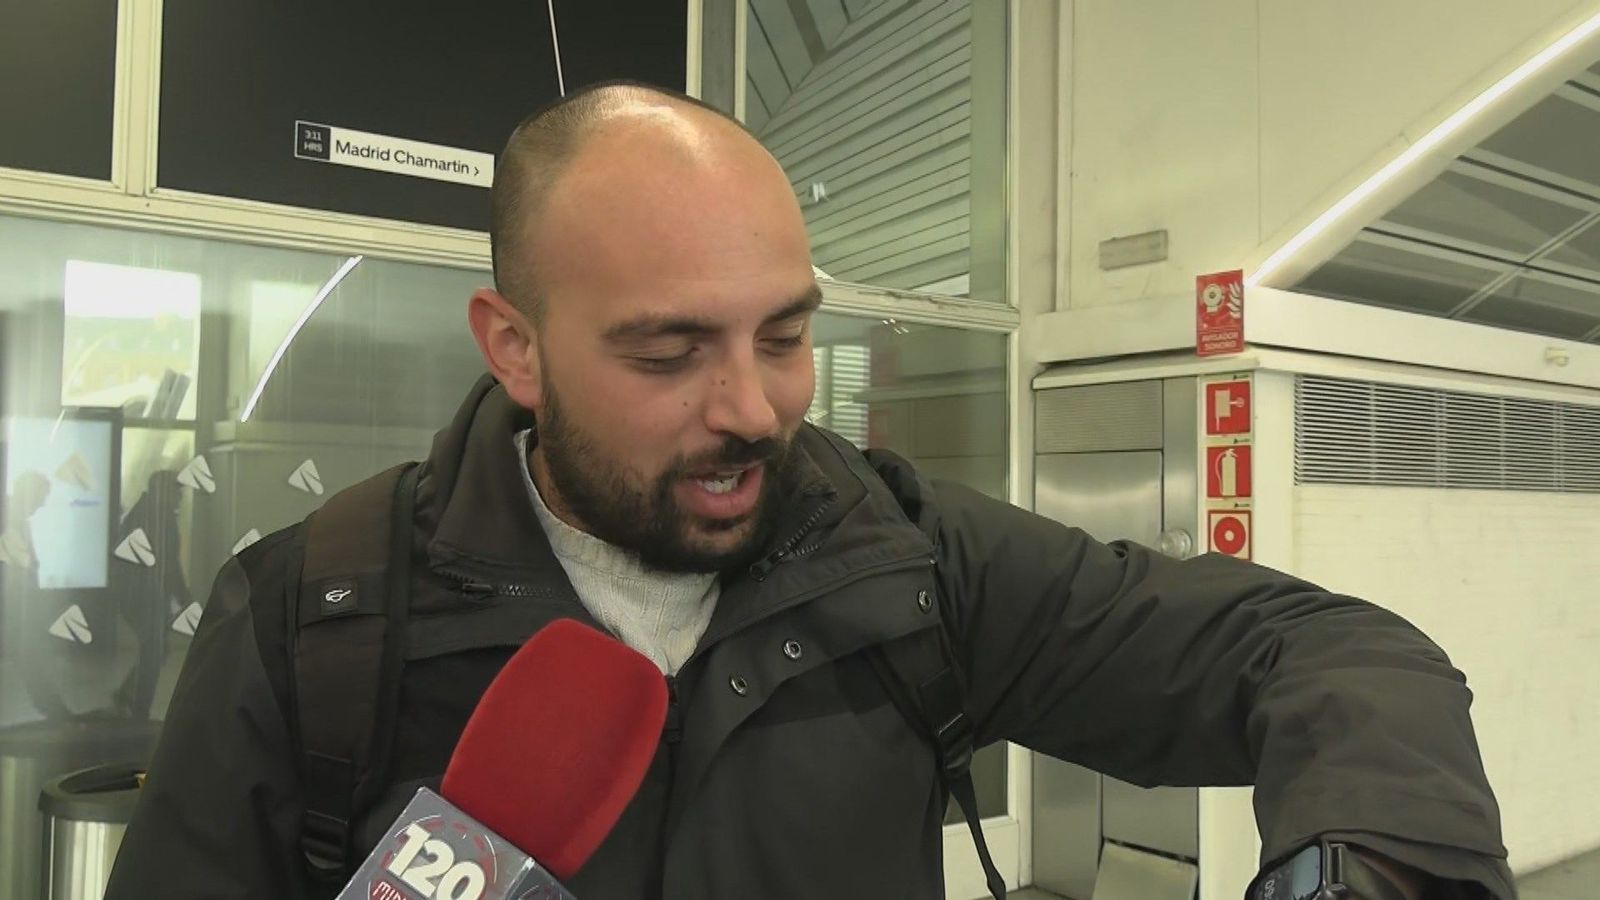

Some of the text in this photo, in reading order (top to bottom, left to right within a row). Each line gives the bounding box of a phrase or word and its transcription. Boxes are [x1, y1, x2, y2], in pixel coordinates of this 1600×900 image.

[335, 139, 470, 175] Madrid Chamartin
[387, 823, 485, 900] 120
